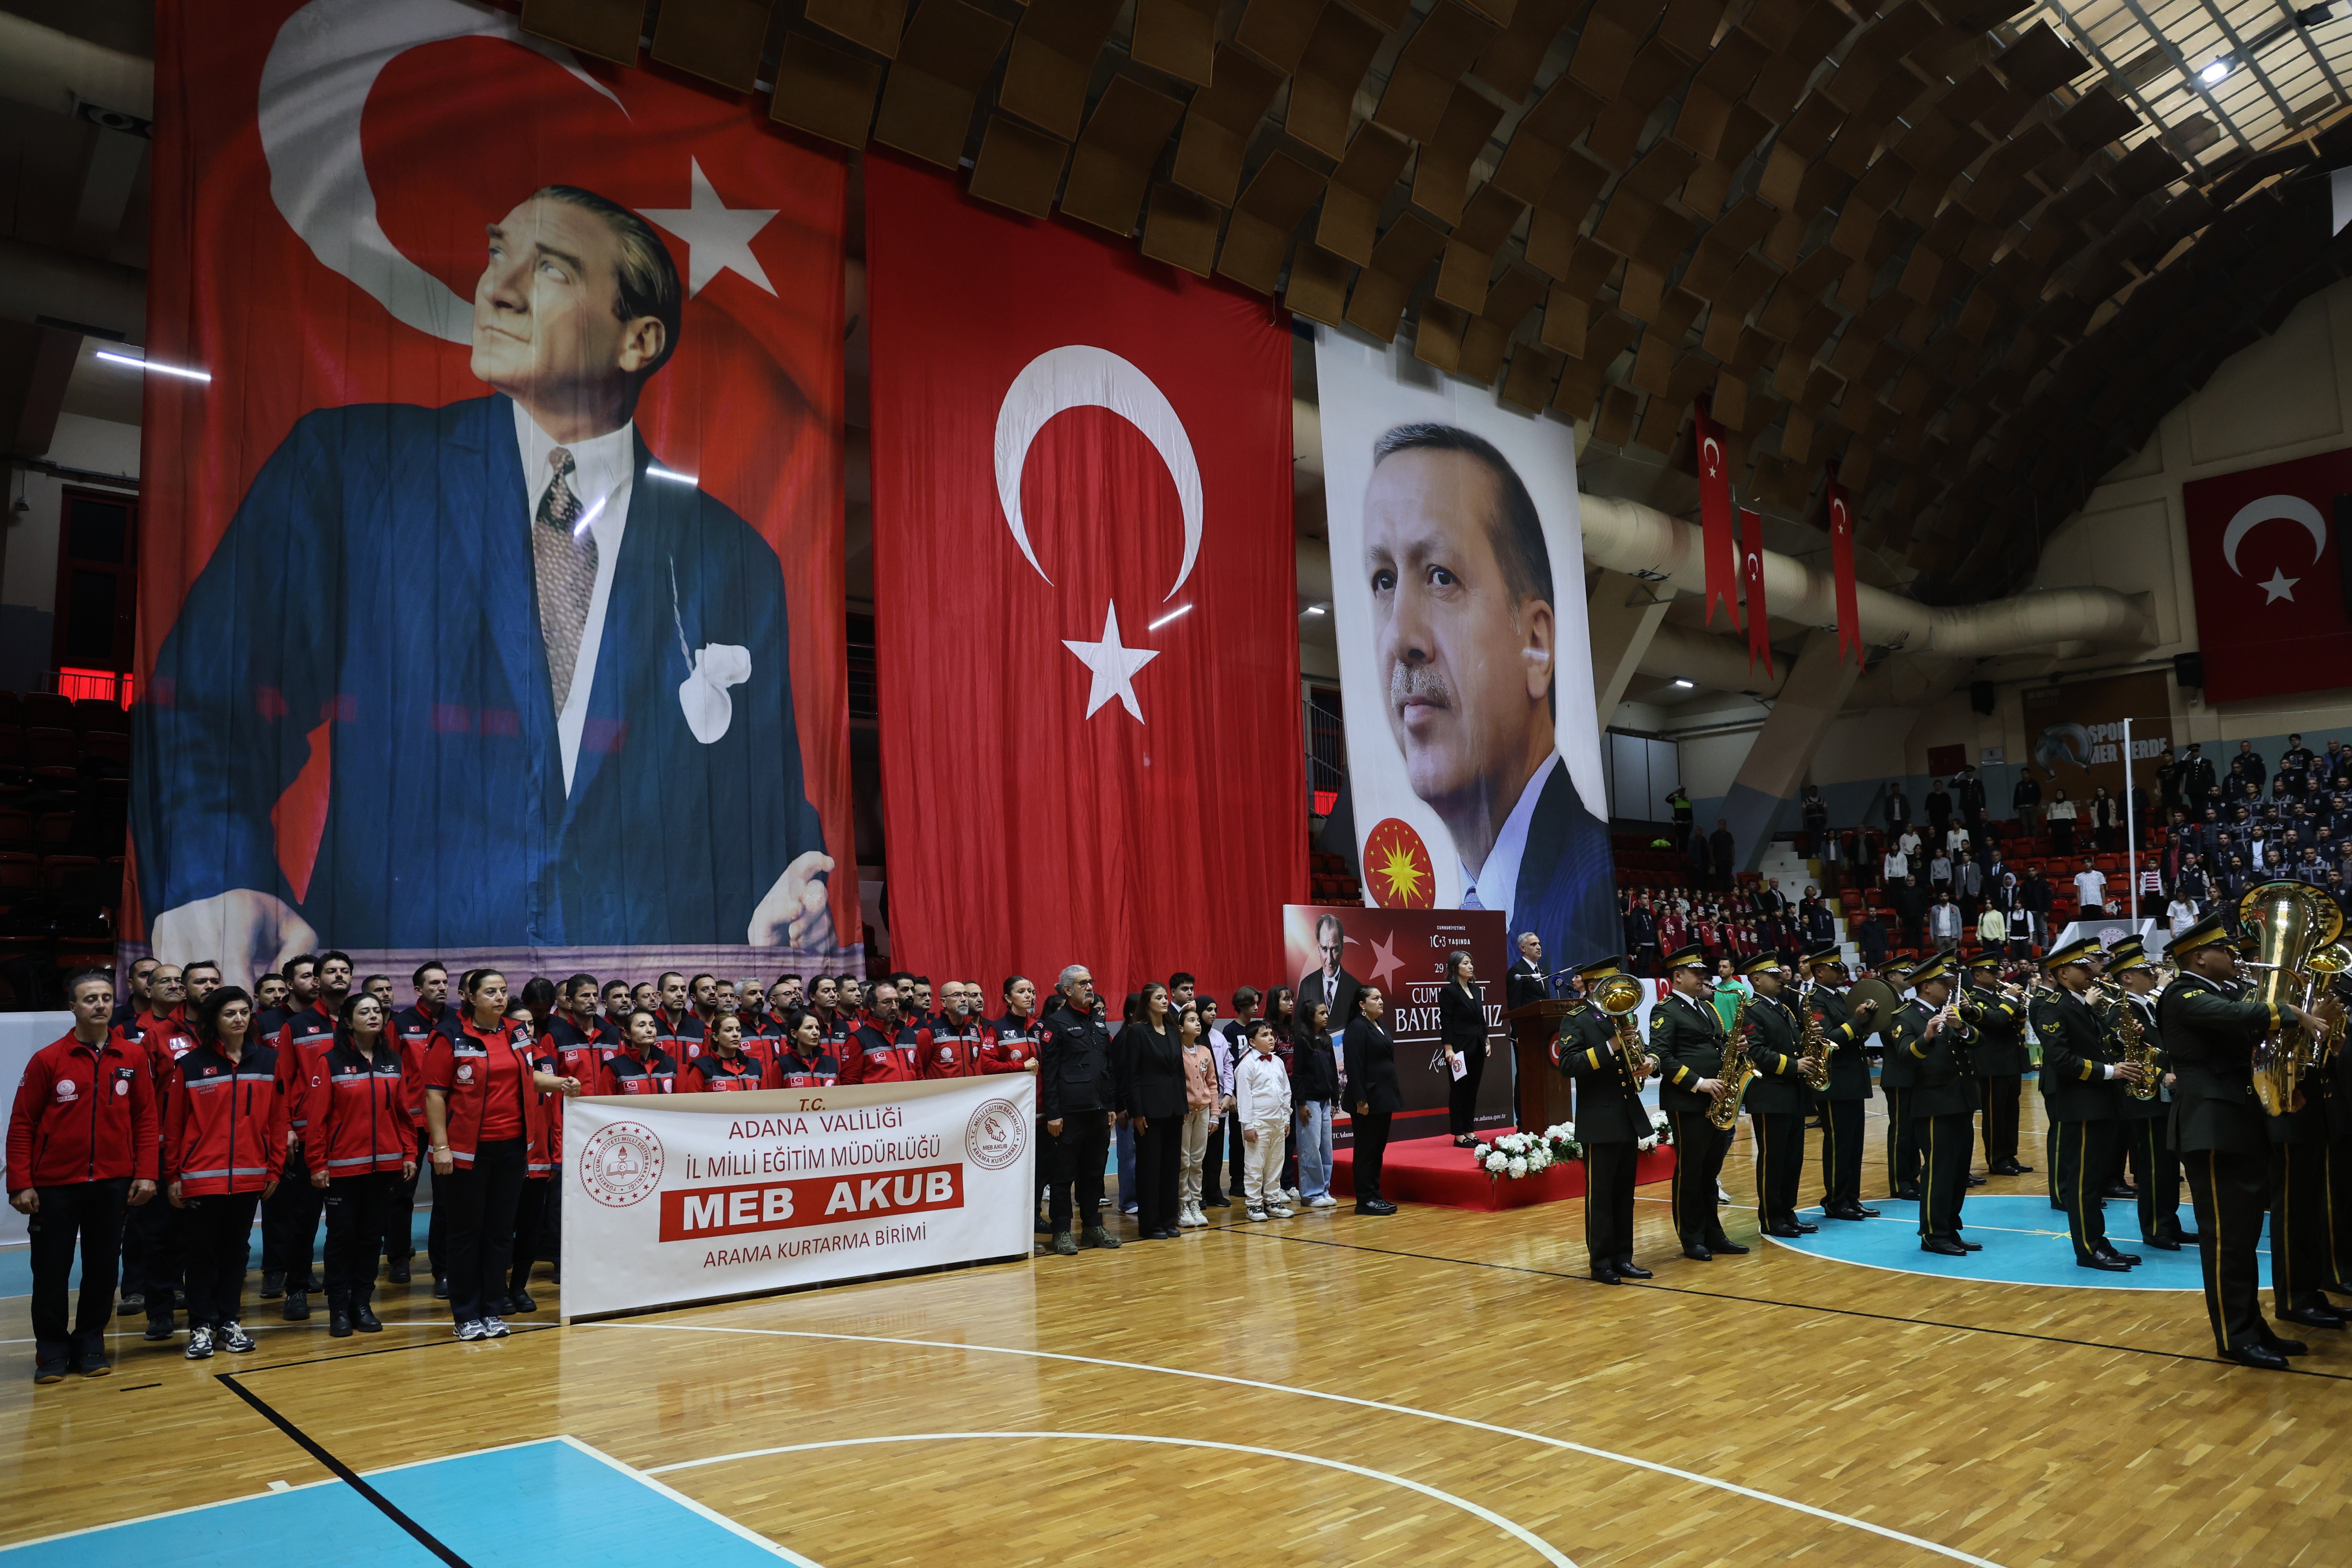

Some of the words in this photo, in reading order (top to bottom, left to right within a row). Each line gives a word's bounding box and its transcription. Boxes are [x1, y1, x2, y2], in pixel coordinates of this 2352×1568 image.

[1435, 963, 1444, 973] 29
[799, 1098, 826, 1112] T.C.
[985, 1104, 1003, 1113] EĞİTİM
[1003, 1107, 1020, 1135] BAKANLIĞI
[728, 1118, 809, 1140] ADANA
[820, 1106, 903, 1133] VALİLİĞİ
[596, 1137, 620, 1172] CUMHURİYETİ
[638, 1142, 649, 1160] EĞİTİM
[686, 1154, 701, 1180] İL
[707, 1148, 756, 1178] MİLLİ
[763, 1143, 825, 1174] EĞİTİM
[831, 1134, 941, 1167] MÜDÜRLÜĞÜ
[973, 1147, 990, 1163] ARAMA
[991, 1144, 1018, 1164] KURTARMA
[597, 1174, 616, 1191] TÜRKİYE
[628, 1162, 649, 1190] BAKANLIĞI
[683, 1187, 794, 1231] MEB
[824, 1171, 954, 1216] AKUB
[703, 1242, 772, 1268] ARAMA
[777, 1232, 871, 1259] KURTARMA
[875, 1221, 926, 1244] BİRİMİ
